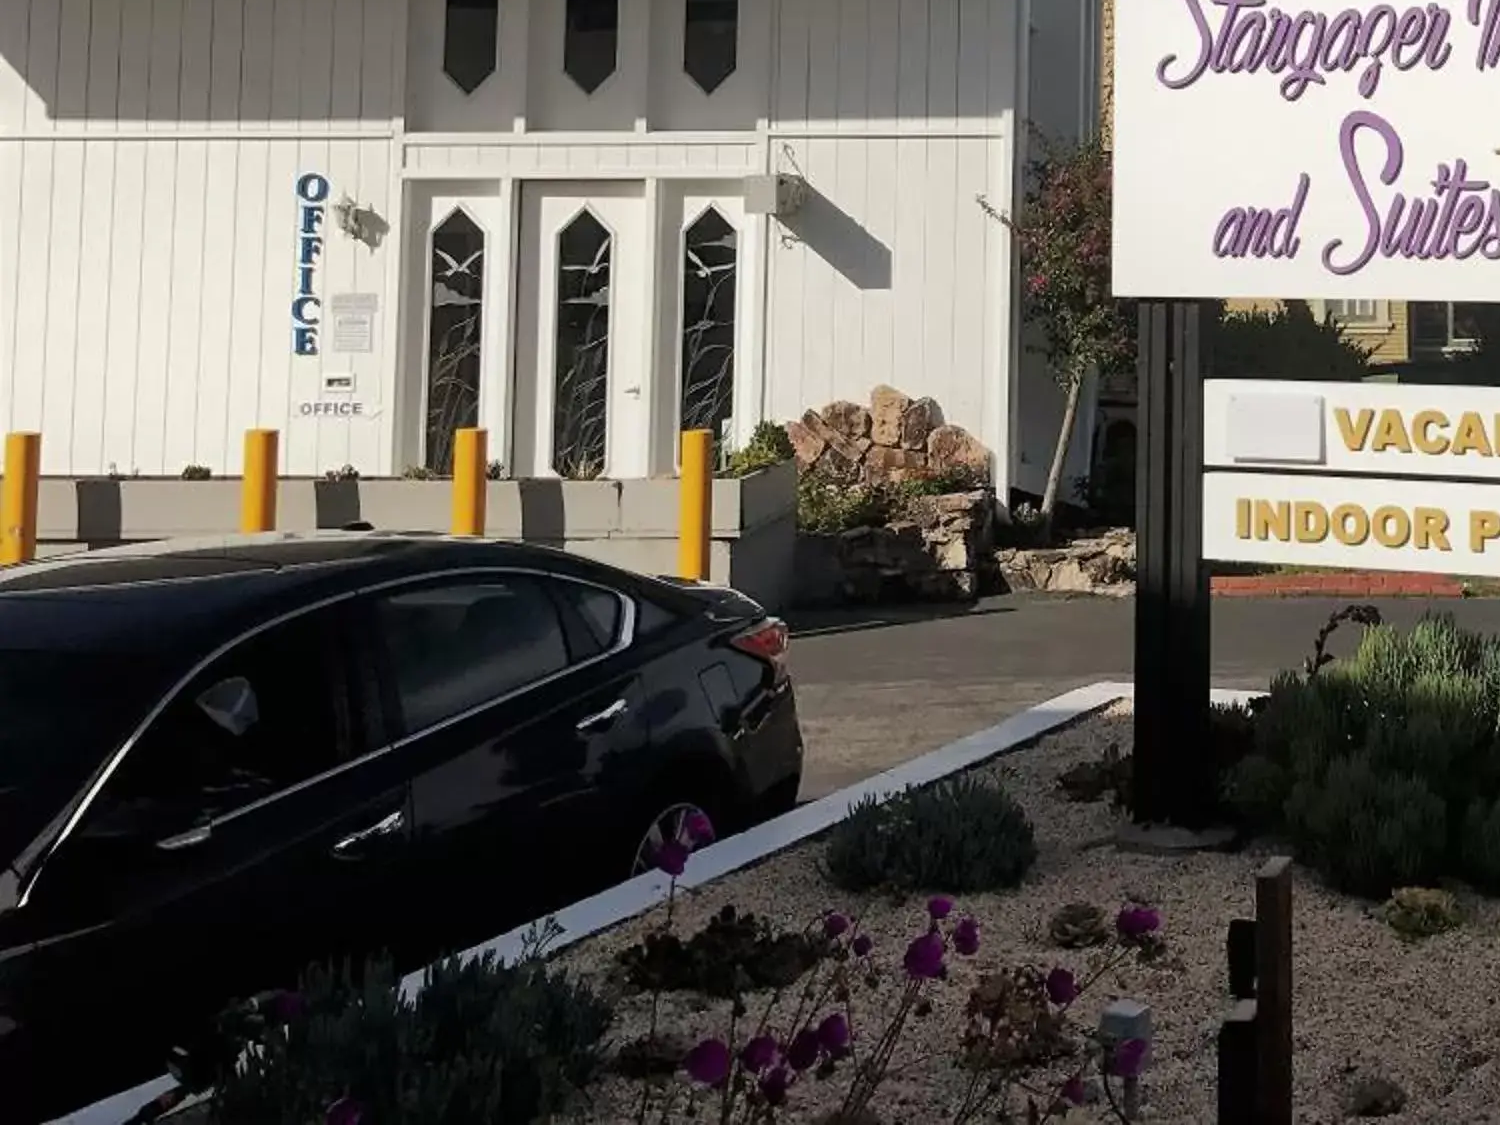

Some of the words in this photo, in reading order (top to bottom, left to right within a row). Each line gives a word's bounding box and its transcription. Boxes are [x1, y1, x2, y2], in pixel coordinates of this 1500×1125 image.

[1212, 172, 1311, 259] and
[291, 172, 330, 356] OFFICE
[300, 402, 364, 416] OFFICE
[1235, 497, 1453, 552] INDOOR
